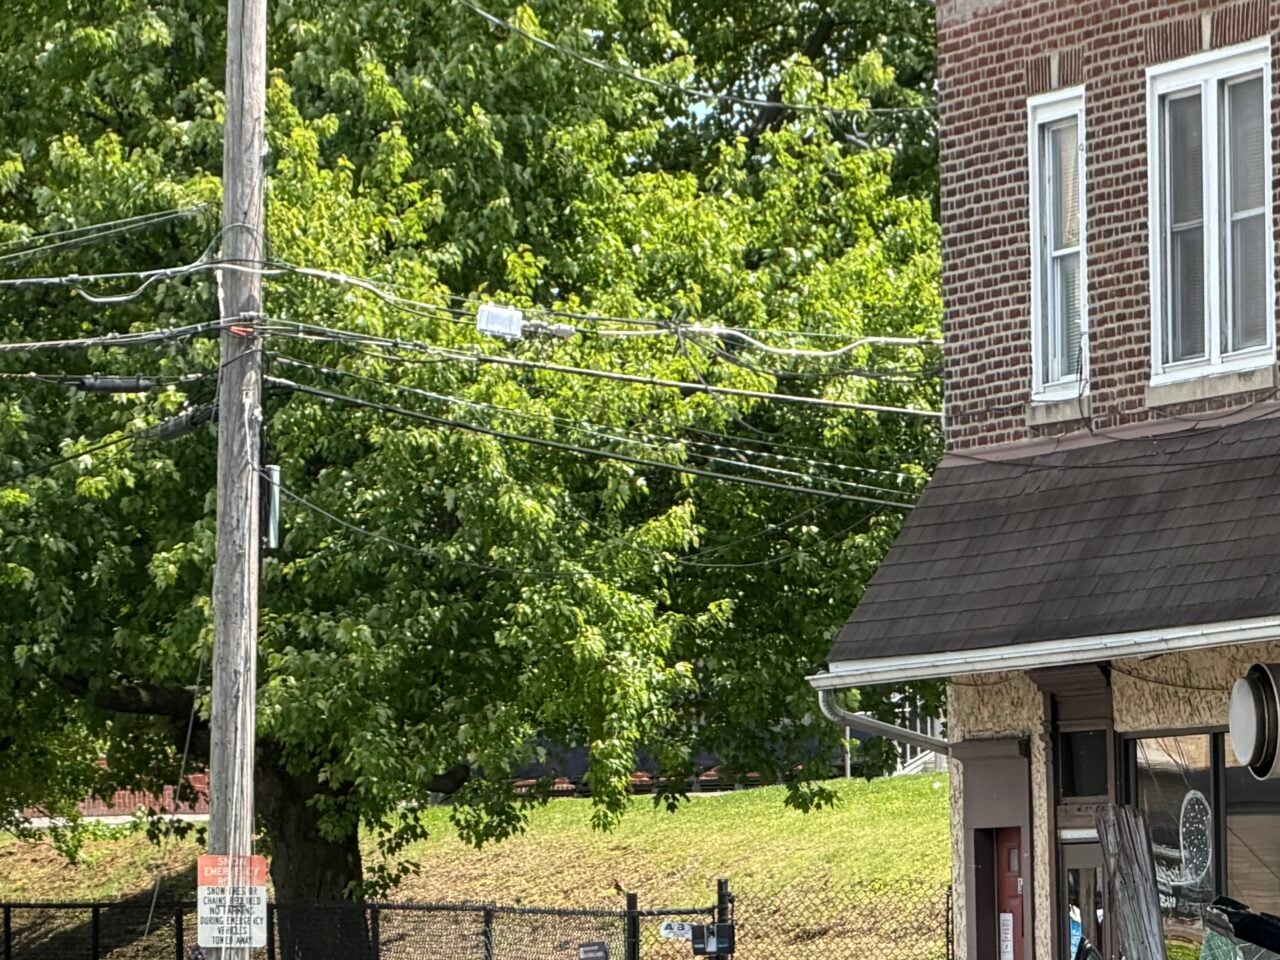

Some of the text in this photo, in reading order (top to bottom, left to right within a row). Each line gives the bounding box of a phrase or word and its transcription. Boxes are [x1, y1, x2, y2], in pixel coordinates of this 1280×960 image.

[203, 896, 227, 905] CHAINS
[209, 905, 220, 915] NO
[200, 916, 264, 925] DURING EMERGENCY
[217, 926, 248, 935] VEHICLES
[212, 935, 252, 945] TOWED AWAY
